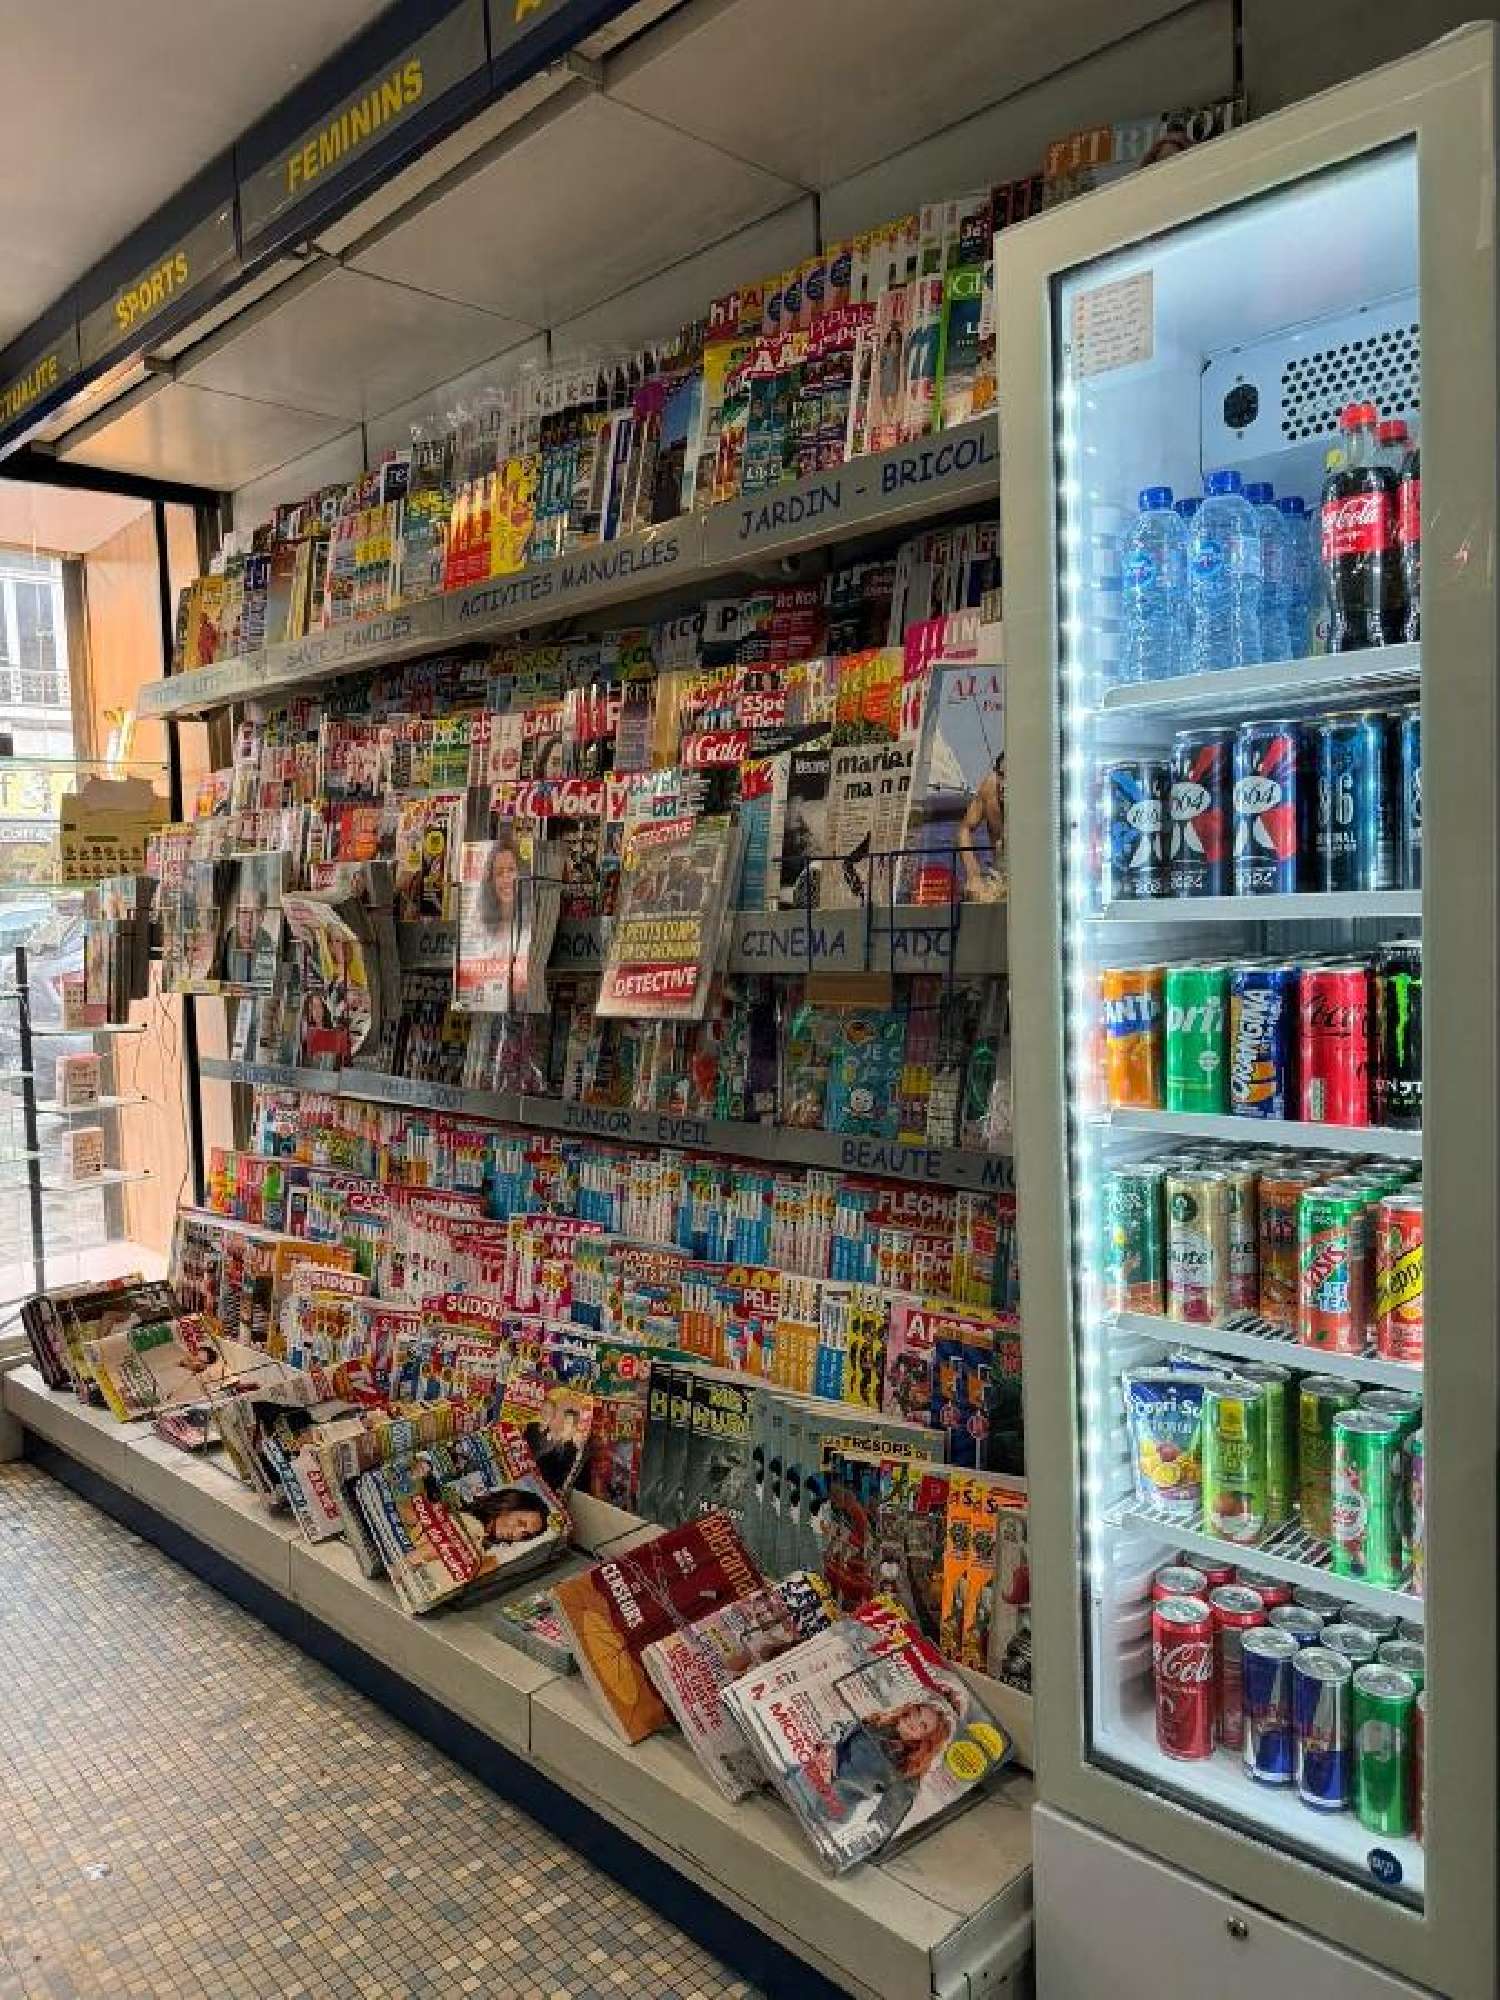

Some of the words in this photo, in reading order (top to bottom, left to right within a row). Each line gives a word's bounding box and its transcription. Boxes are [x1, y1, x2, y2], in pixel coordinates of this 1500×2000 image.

[287, 55, 423, 193] FEMININS
[116, 251, 190, 330] SPORTS
[0, 354, 58, 424] TUALITE
[738, 480, 841, 538] JARDIN
[459, 578, 553, 621] ACTIVITES
[560, 540, 679, 589] MANUELLES
[741, 929, 846, 958] CINEMA
[614, 966, 698, 998] DETECTIVE
[563, 1106, 632, 1137] JUNIOR
[841, 1139, 942, 1179] BEAUTE
